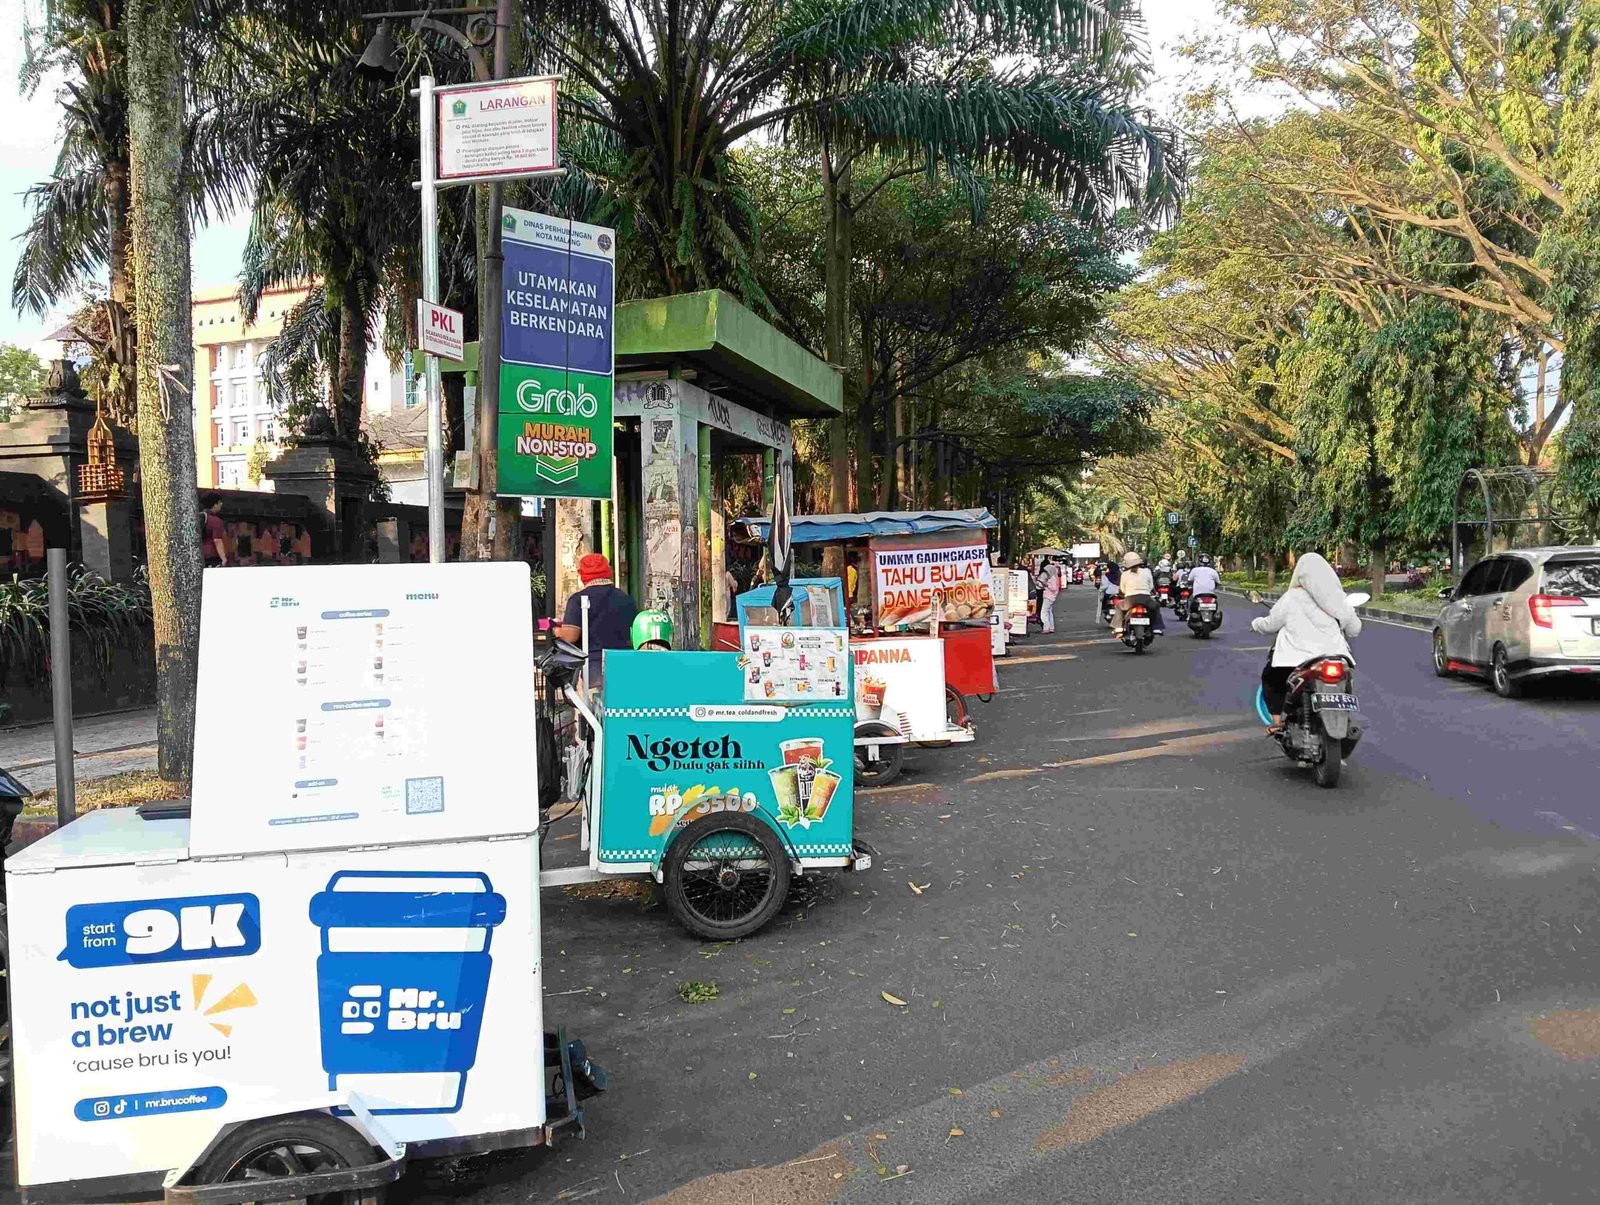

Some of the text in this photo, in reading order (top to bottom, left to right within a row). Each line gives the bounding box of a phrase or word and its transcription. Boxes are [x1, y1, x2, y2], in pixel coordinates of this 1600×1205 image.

[480, 95, 546, 111] LARANGAN
[523, 219, 592, 241] DINAS PERHUBUNGAN
[535, 232, 581, 247] KOTA MALANG
[518, 271, 597, 299] UTAMAKAN
[506, 289, 607, 320] KESELAMATAN
[431, 309, 455, 334] PKL
[510, 310, 604, 339] BERKENDARA
[516, 379, 598, 418] Grab
[524, 422, 591, 443] MURAH
[879, 553, 914, 566] UMKM
[882, 561, 983, 586] TAHU BULAT
[883, 583, 990, 610] DAN SOTONG
[854, 648, 912, 666] IPANNA
[626, 734, 742, 772] Ngeteh
[673, 759, 765, 774] Dulu gak siihh
[648, 791, 757, 816] RP 3500
[82, 903, 246, 955] start 9K
[82, 936, 117, 949] from
[71, 990, 181, 1023] not just
[388, 988, 445, 1009] Mr.
[387, 1010, 462, 1030] Bru
[71, 1023, 173, 1048] a brew
[138, 1053, 169, 1067] bru
[174, 1049, 188, 1064] is
[192, 1045, 231, 1066] you!
[145, 1094, 208, 1109] mr.brucoffee
